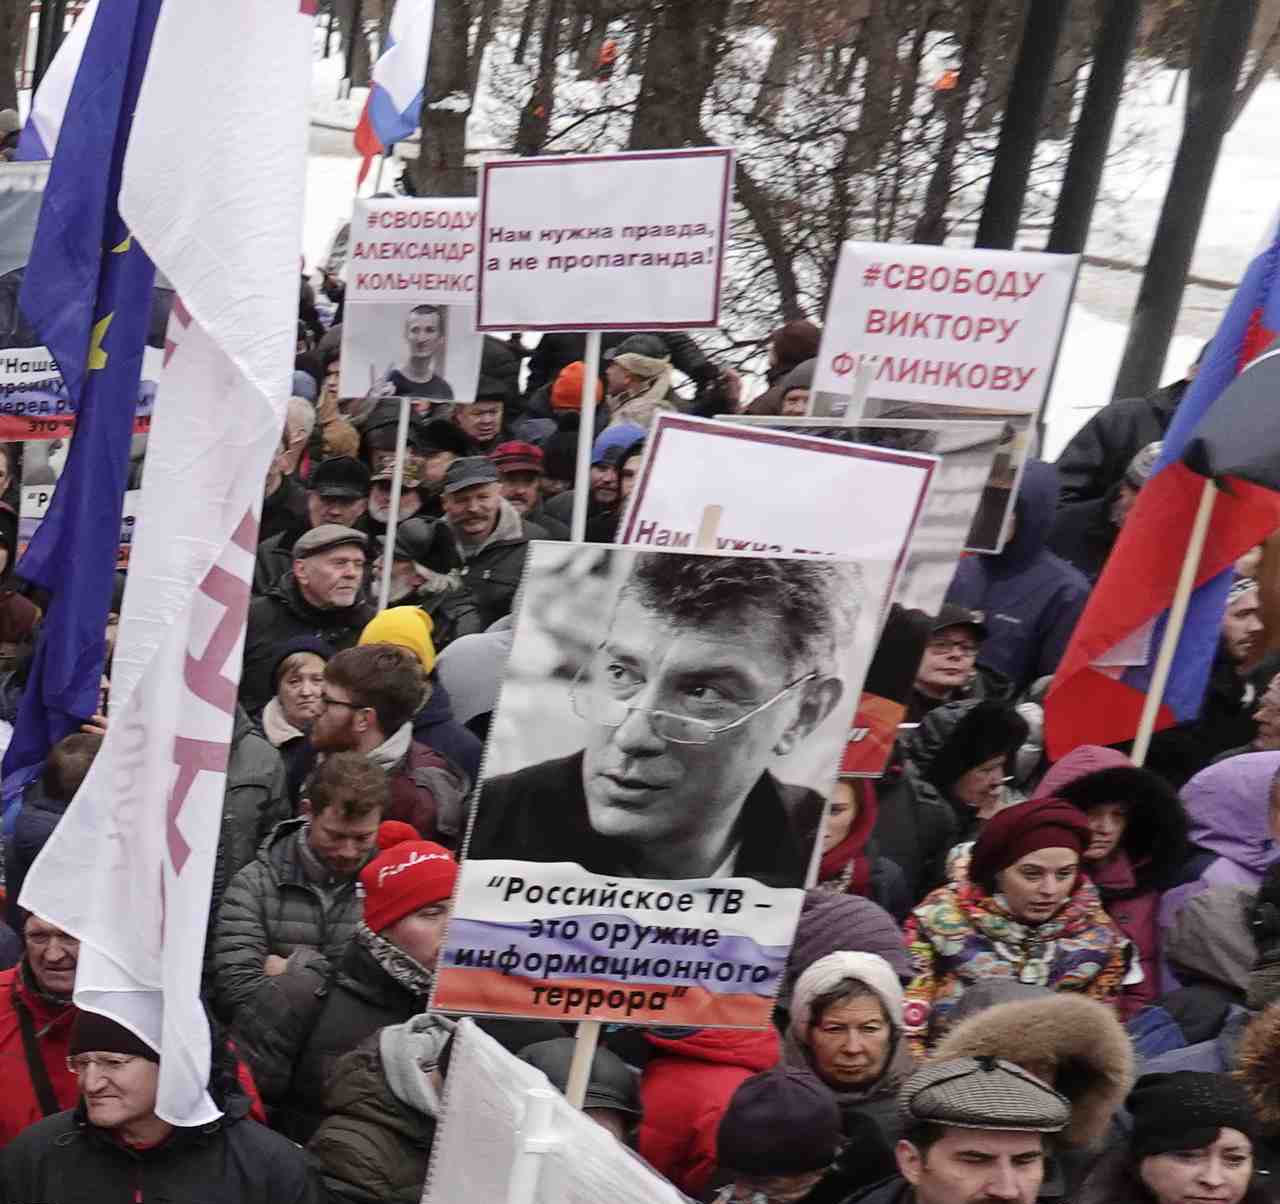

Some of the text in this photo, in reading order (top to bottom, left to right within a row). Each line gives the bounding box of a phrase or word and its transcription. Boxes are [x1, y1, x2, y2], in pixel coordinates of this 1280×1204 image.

[368, 211, 478, 231] #СВОБОДУ
[489, 222, 715, 244] Нам нужна правда,
[487, 247, 714, 272] а не пропаганда!
[863, 263, 1046, 301] #СВОБОДУ
[865, 308, 1021, 343] ВИКТОРУ
[831, 352, 1039, 391] ФЛИНКОВУ
[488, 876, 694, 913] “Российское
[704, 886, 744, 915] ТВ
[528, 917, 720, 949] это оружие
[453, 945, 770, 984] информационного
[532, 984, 690, 1016] террора”
